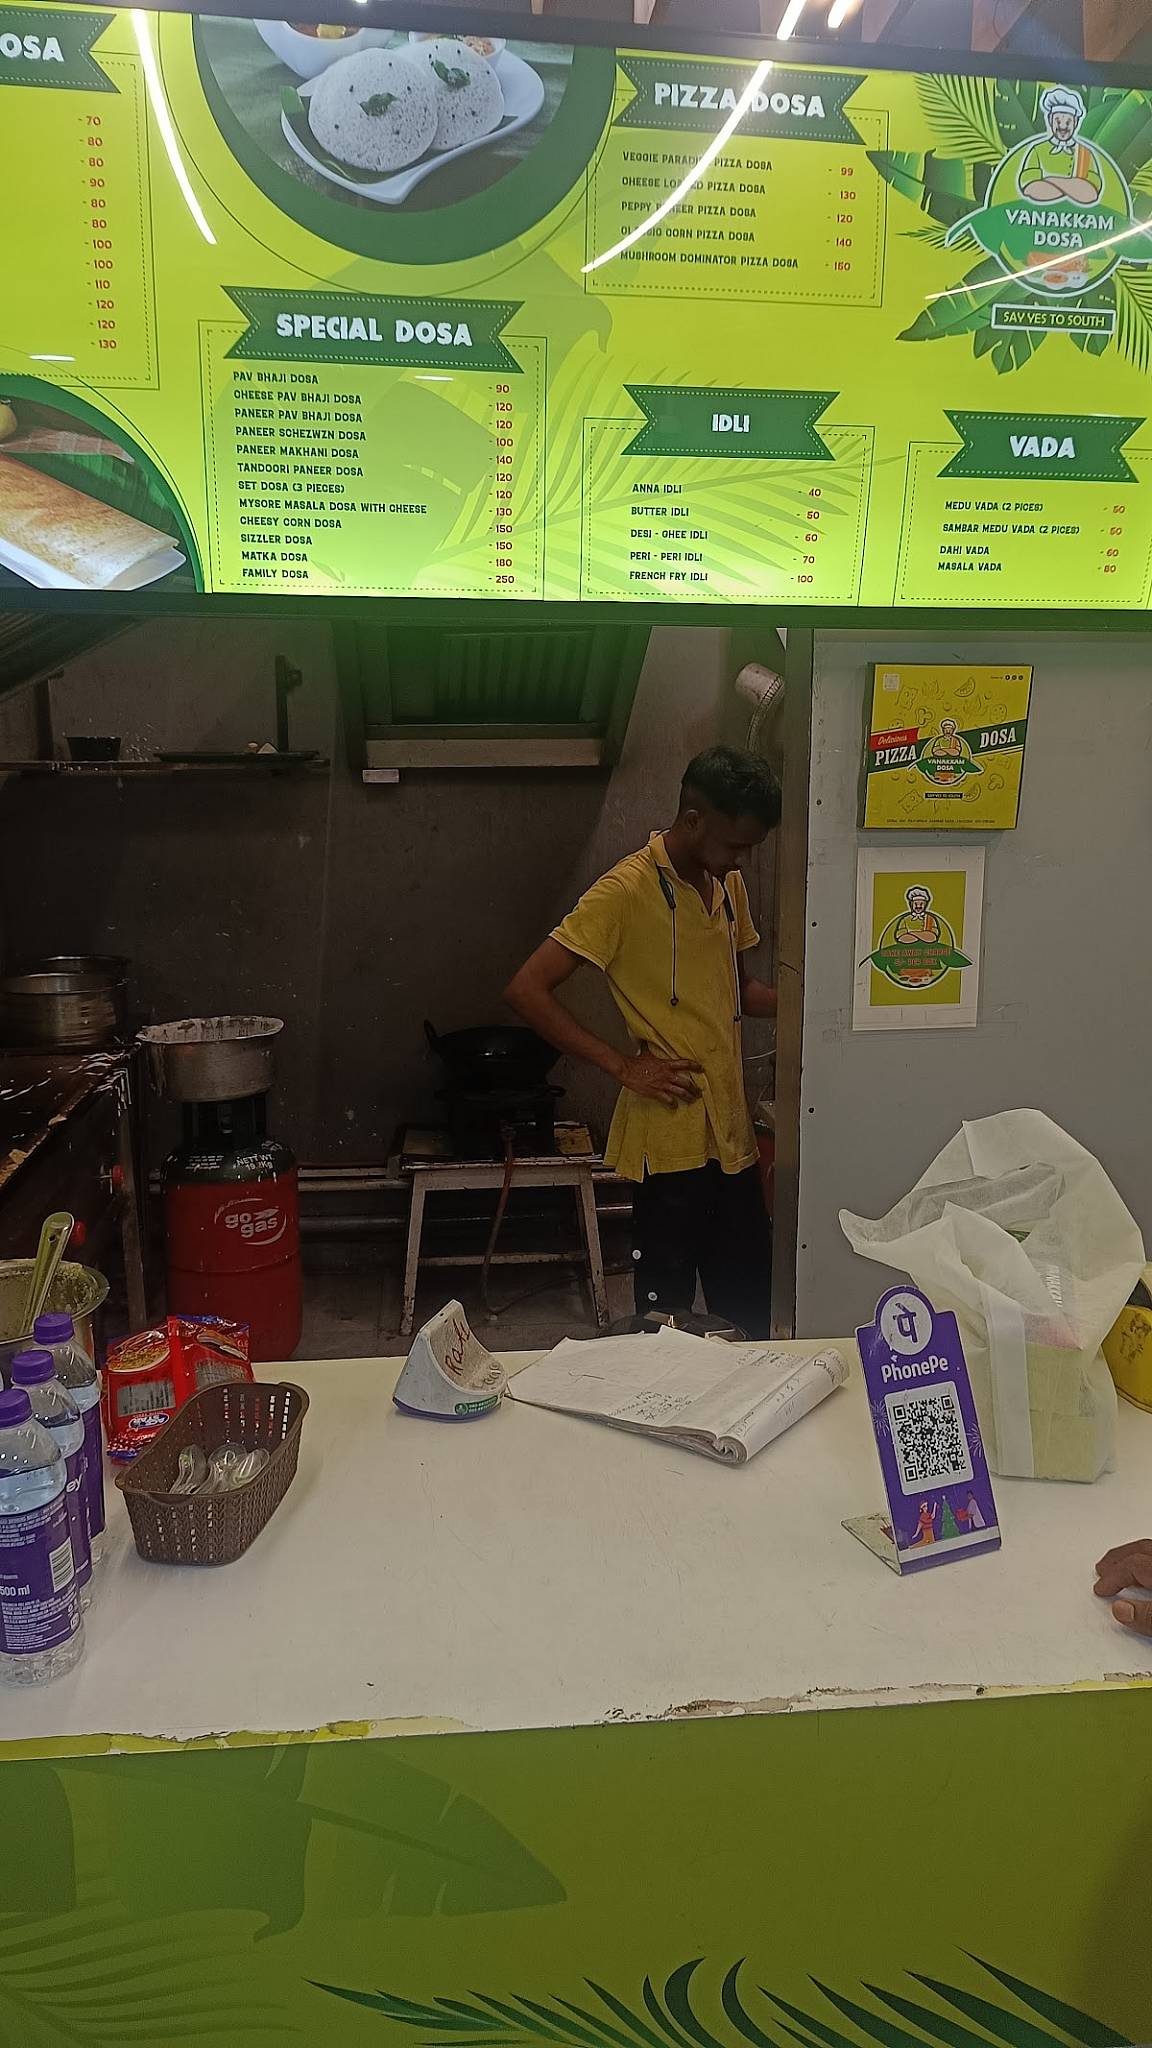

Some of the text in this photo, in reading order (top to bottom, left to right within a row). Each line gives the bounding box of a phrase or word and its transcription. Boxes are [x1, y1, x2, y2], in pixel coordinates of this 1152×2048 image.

[0, 35, 65, 63] OSA
[654, 82, 825, 118] PIZZA DOSA
[86, 116, 101, 126] 70
[88, 136, 103, 147] 80
[89, 158, 104, 168] 80
[622, 151, 659, 163] VEGGIE
[715, 157, 742, 169] PIZZA
[746, 160, 773, 171] DOSA
[841, 167, 853, 176] 99
[89, 178, 105, 188] 90
[622, 177, 661, 188] CHEESE
[707, 181, 735, 192] PIZZA
[739, 183, 766, 195] DOSA
[840, 191, 856, 200] 130
[91, 199, 106, 208] 80
[621, 201, 652, 212] PEPPY
[697, 205, 725, 216] PIZZA
[729, 207, 756, 218] DOSA
[837, 215, 853, 223] 120
[1006, 209, 1115, 231] VANAKKAM
[92, 219, 107, 229] 80
[93, 239, 112, 249] 100
[665, 228, 693, 239] CORN
[696, 230, 725, 241] PIZZA
[728, 231, 755, 242] DOSA
[835, 238, 852, 247] 140
[1034, 230, 1083, 248] DOSA
[94, 260, 113, 269] 100
[620, 251, 676, 263] MUSHROOM
[680, 253, 737, 265] DOMINATOR
[740, 256, 768, 267] PIZZA
[772, 258, 798, 269] DOSA
[95, 280, 110, 289] 110
[96, 300, 114, 310] 120
[97, 320, 115, 329] 120
[1003, 311, 1105, 326] SAY YES TO SOUTH
[276, 313, 473, 347] SPECIAL DOSA
[98, 339, 116, 349] 130
[233, 371, 509, 394] PAV BHAJI DOSA 90
[234, 390, 512, 412] CHEESE PAV BHAJI DOSA 120
[234, 408, 512, 430] PANEER PAV BHAJI DOSA 120
[712, 414, 750, 433] IDLI
[235, 427, 275, 438] PANEER
[338, 431, 366, 441] DOSA
[496, 437, 513, 447] 100
[236, 444, 512, 465] PANEER MAKHANI DOSA 140
[1009, 435, 1076, 459] VADA
[237, 462, 512, 482] TANDOORI PANEER DOSA 120
[238, 481, 257, 491] SET
[261, 482, 288, 492] DOSA
[306, 483, 345, 494] PIECES)
[496, 490, 512, 499] 120
[632, 483, 821, 497] ANNA IDLI 40
[239, 499, 512, 517] MYSORE MASALA DOSA WITH CHEESE 130
[631, 507, 820, 520] BUTTER IDLI 50
[945, 501, 971, 510] MEDU
[975, 502, 999, 511] VADA
[1014, 502, 1043, 512] PICES)
[240, 516, 512, 533] CHEESY CORN DOSA 150
[943, 523, 979, 533] SAMBAR
[982, 524, 1008, 534] MEDU
[1012, 525, 1035, 534] VADA
[1051, 526, 1080, 535] PICES)
[241, 534, 512, 550] SIZZLER DOSA 150
[630, 530, 818, 542] DESI GHEE IDLI 60
[630, 552, 815, 564] PERI PERI IDLI 70
[940, 546, 962, 555] DAHI
[966, 546, 990, 555] VADA
[241, 551, 512, 567] MATKA DOSA 180
[937, 562, 974, 571] MASALA
[978, 563, 1002, 571] VADA
[242, 568, 515, 584] FAMILY DOSA 250
[629, 571, 813, 583] FRENCH FRY IDLI 100
[875, 727, 1016, 766] PIZZA DOSA
[225, 1213, 252, 1229] go
[240, 1217, 278, 1238] gas
[881, 1355, 948, 1383] PhonePe
[0, 1584, 30, 1597] 500 ml
